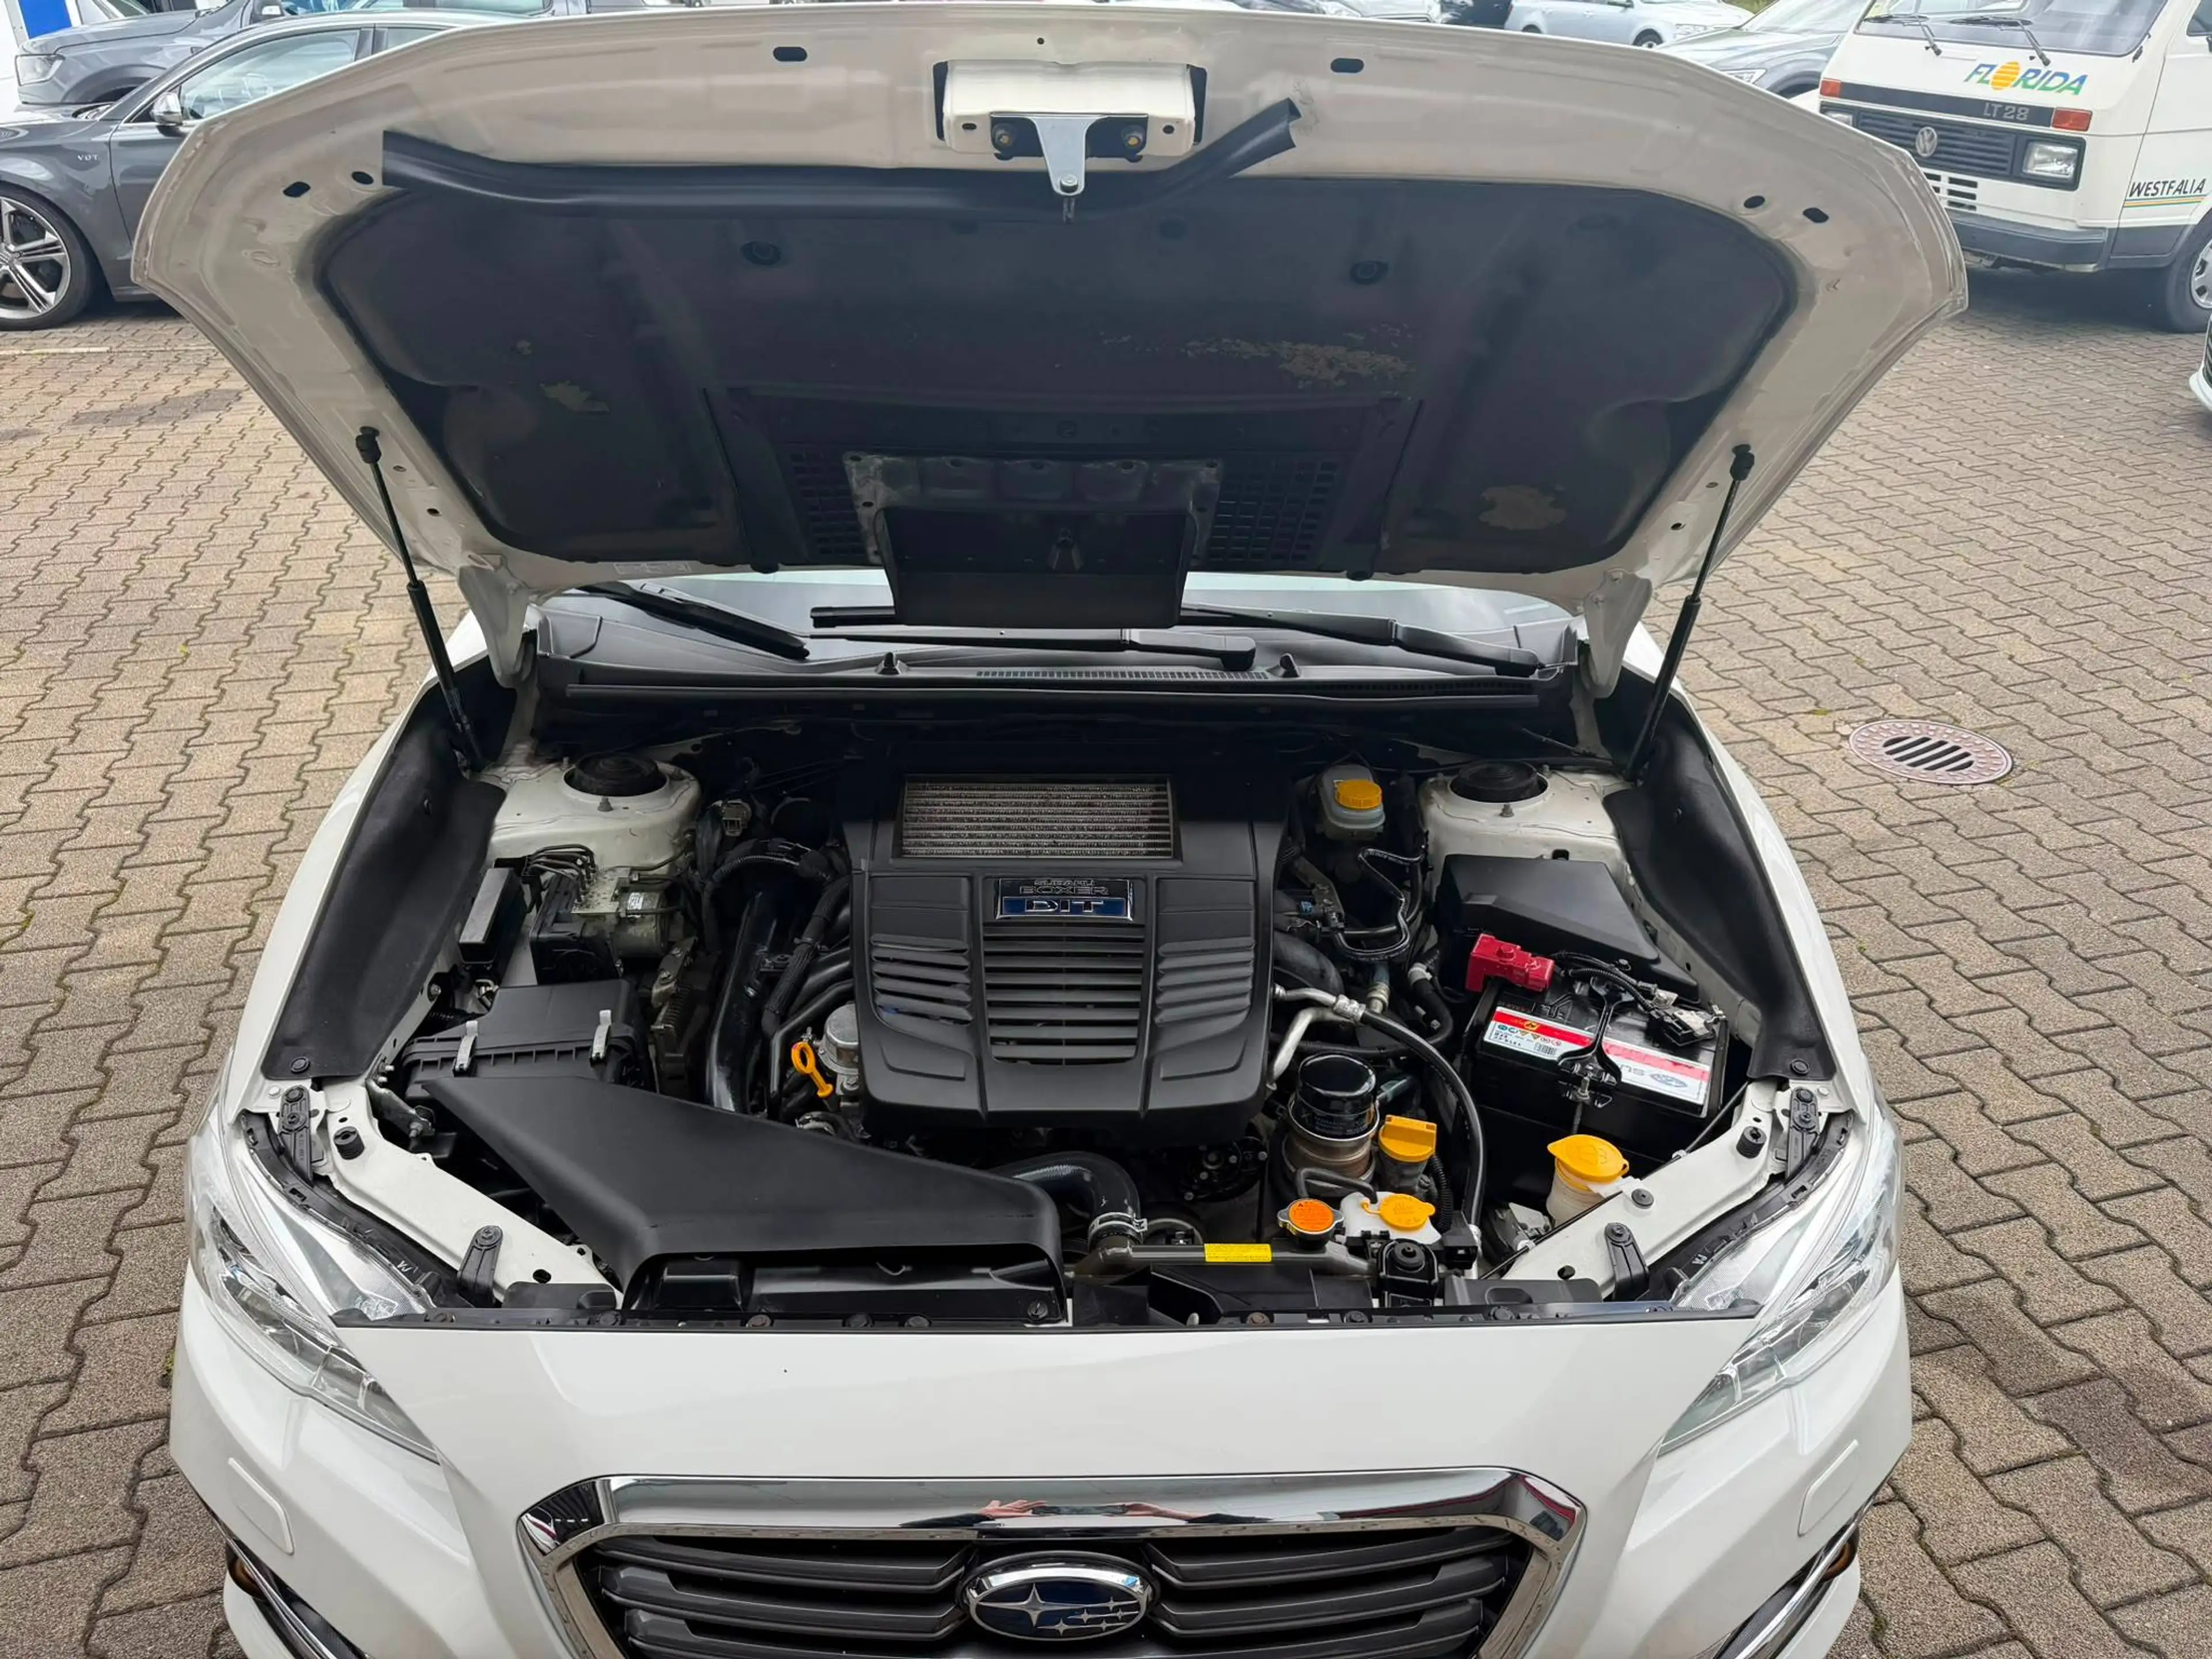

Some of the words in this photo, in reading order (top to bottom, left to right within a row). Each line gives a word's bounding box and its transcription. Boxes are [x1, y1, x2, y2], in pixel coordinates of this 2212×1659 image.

[1963, 61, 2089, 96] FLORIDA
[1983, 102, 2003, 118] LT
[2003, 105, 2030, 121] 28
[2128, 178, 2207, 198] WESTFALIA
[1019, 886, 1109, 895] BOXER
[1024, 898, 1104, 913] DIT
